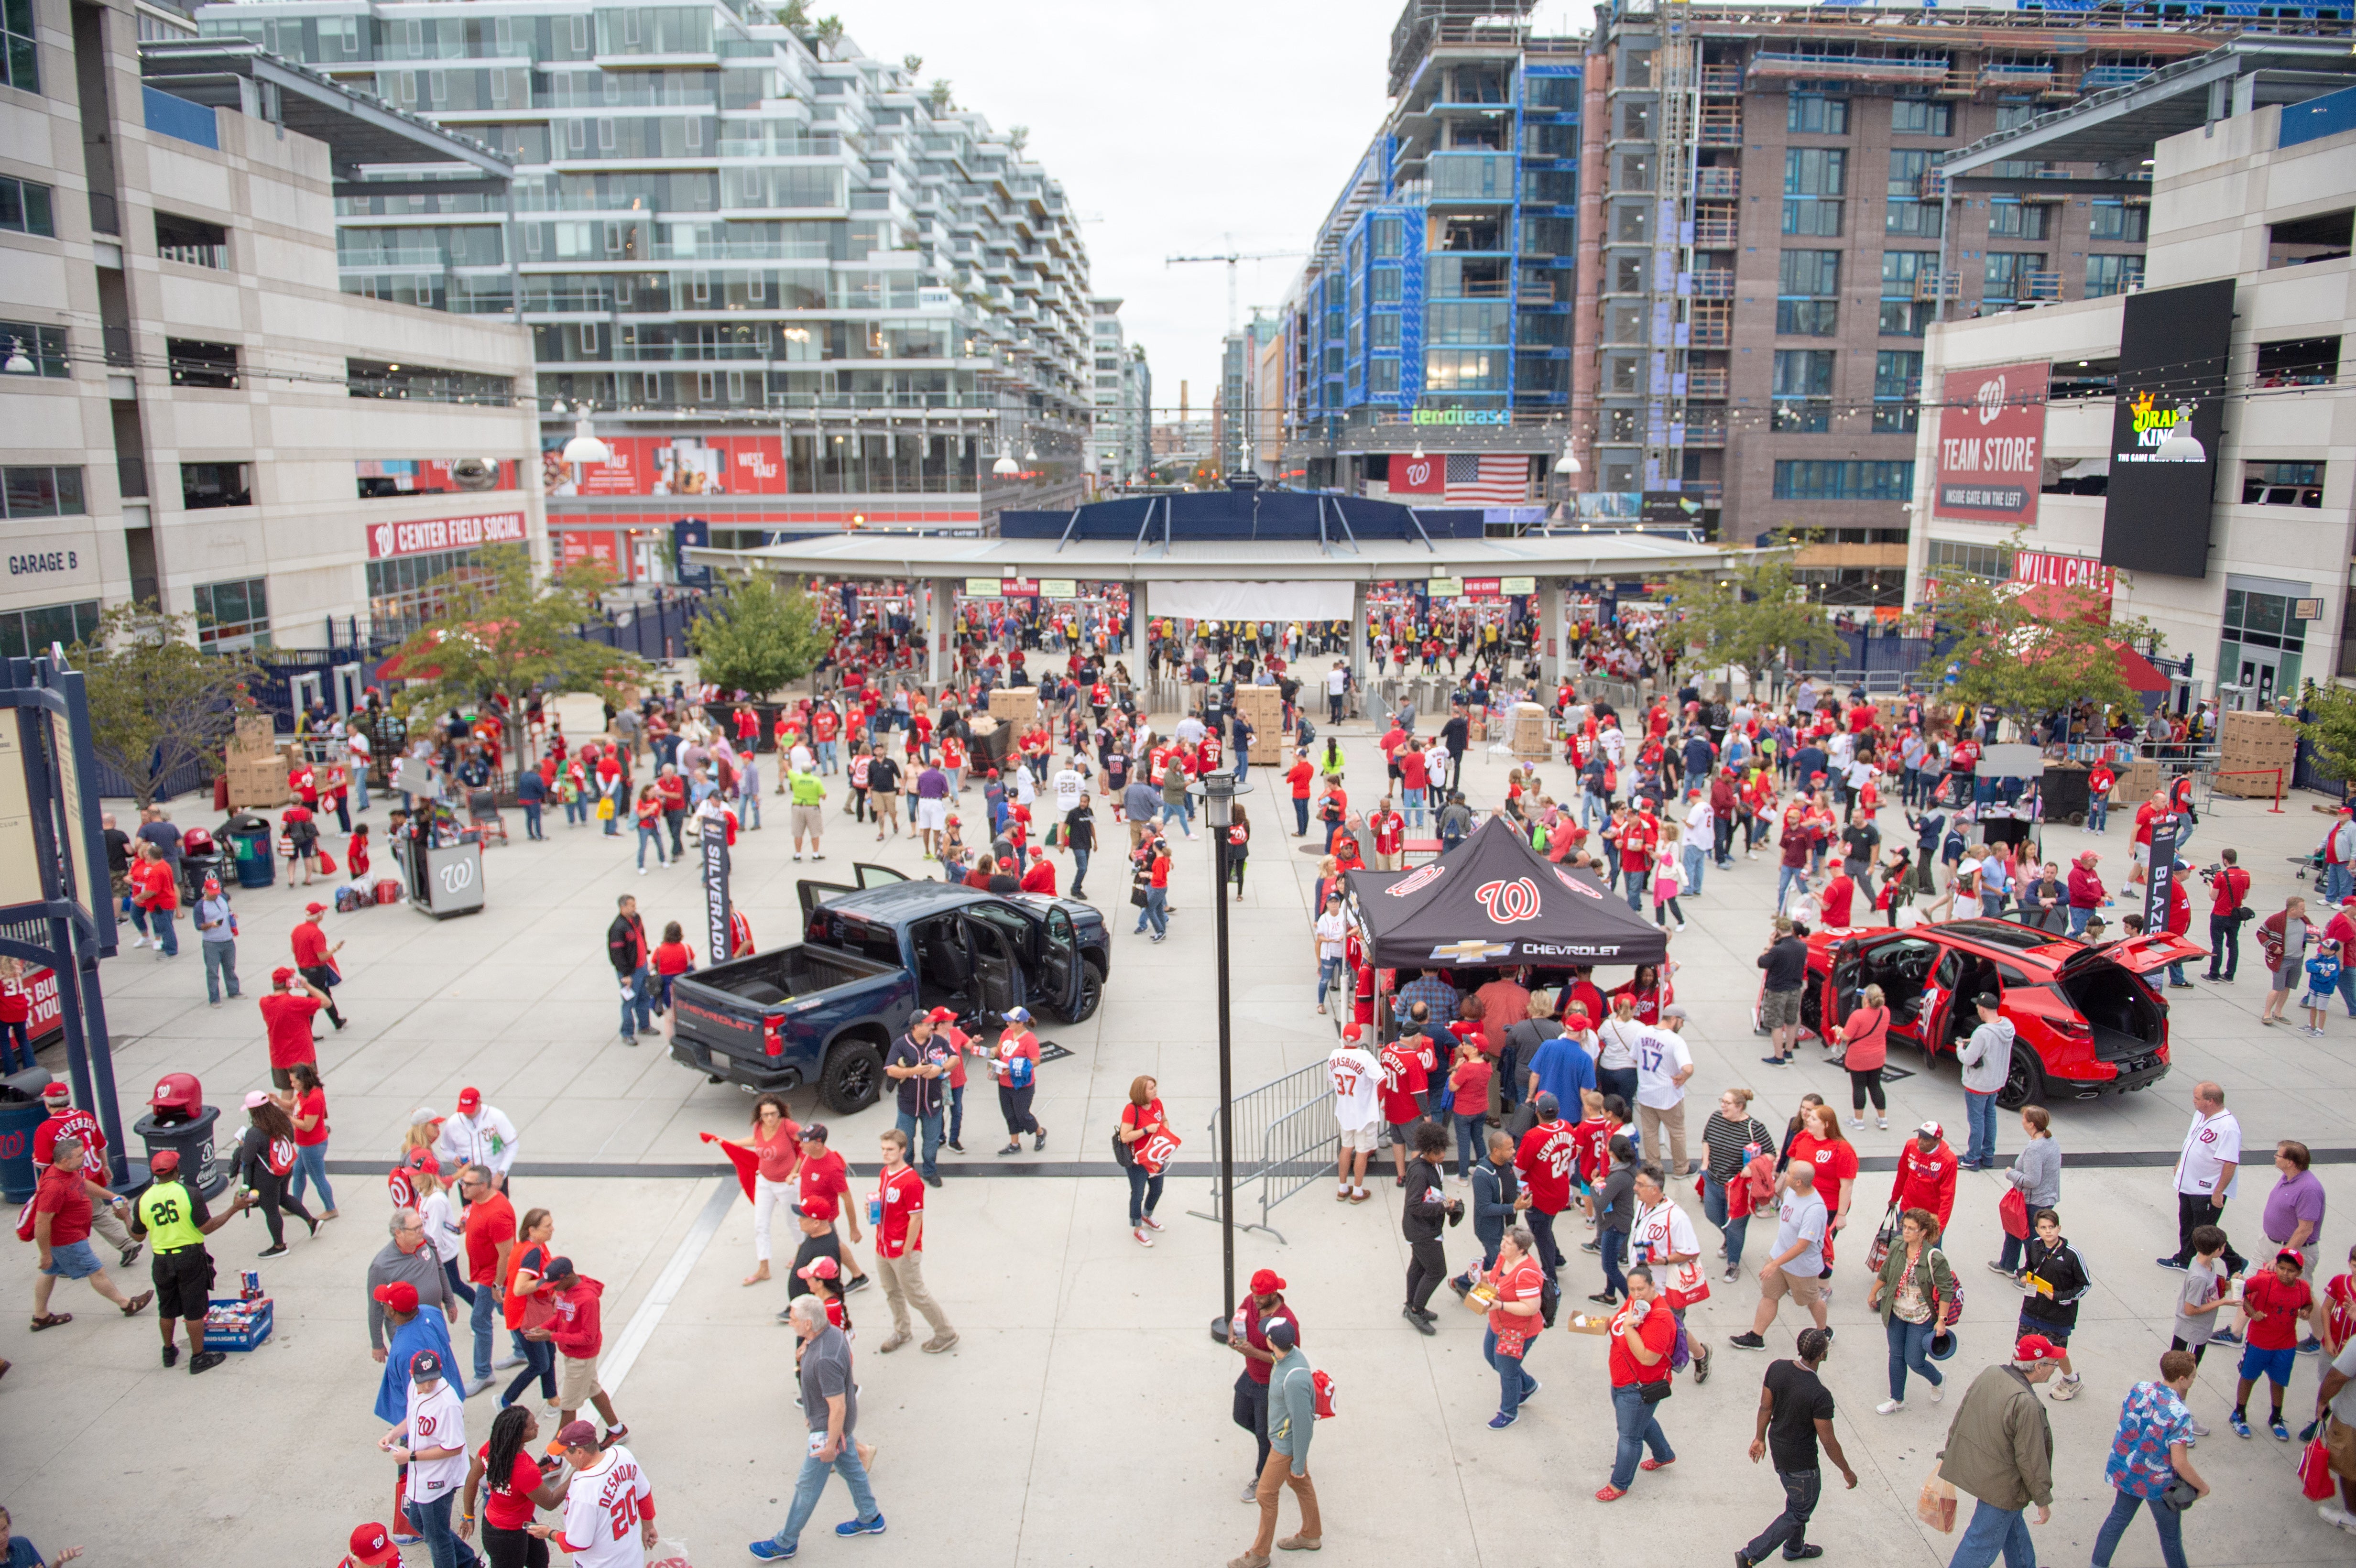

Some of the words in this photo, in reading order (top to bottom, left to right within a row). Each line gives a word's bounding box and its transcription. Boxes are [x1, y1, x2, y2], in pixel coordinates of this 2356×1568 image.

[1412, 404, 1511, 425] lendlease
[738, 452, 765, 467] WEST
[1943, 437, 1981, 471] TEAM
[1984, 436, 2036, 472] STORE
[2118, 453, 2130, 462] THE
[2130, 453, 2149, 462] GAME
[753, 464, 777, 478] HALF
[1945, 489, 1965, 505] INSIDE
[1966, 490, 1981, 505] GATE
[1982, 490, 1991, 506] ON
[1993, 491, 2004, 507] THE
[2005, 491, 2021, 508] LEFT
[398, 522, 447, 552] CENTER
[449, 518, 482, 545] FIELD
[483, 513, 523, 541] SOCIAL
[9, 552, 65, 575] GARAGE
[69, 551, 77, 569] B
[2018, 553, 2057, 586] WILL
[2064, 558, 2110, 594] CALL
[1003, 583, 1010, 591] NO
[1464, 583, 1472, 591] NO
[1206, 750, 1219, 762] 31
[1060, 782, 1076, 794] 22
[708, 844, 726, 960] SILVERADO
[1475, 876, 1541, 924] W
[1522, 943, 1621, 956] CHEVROLET
[677, 999, 755, 1032] CHEVROLET
[1329, 1056, 1365, 1075] STRASBURG
[1642, 1048, 1663, 1072] 17
[1334, 1073, 1356, 1097] 37
[1550, 1148, 1572, 1179] 22
[151, 1198, 180, 1226] 26
[599, 1463, 638, 1509] DESMOND
[610, 1484, 638, 1542] 20
